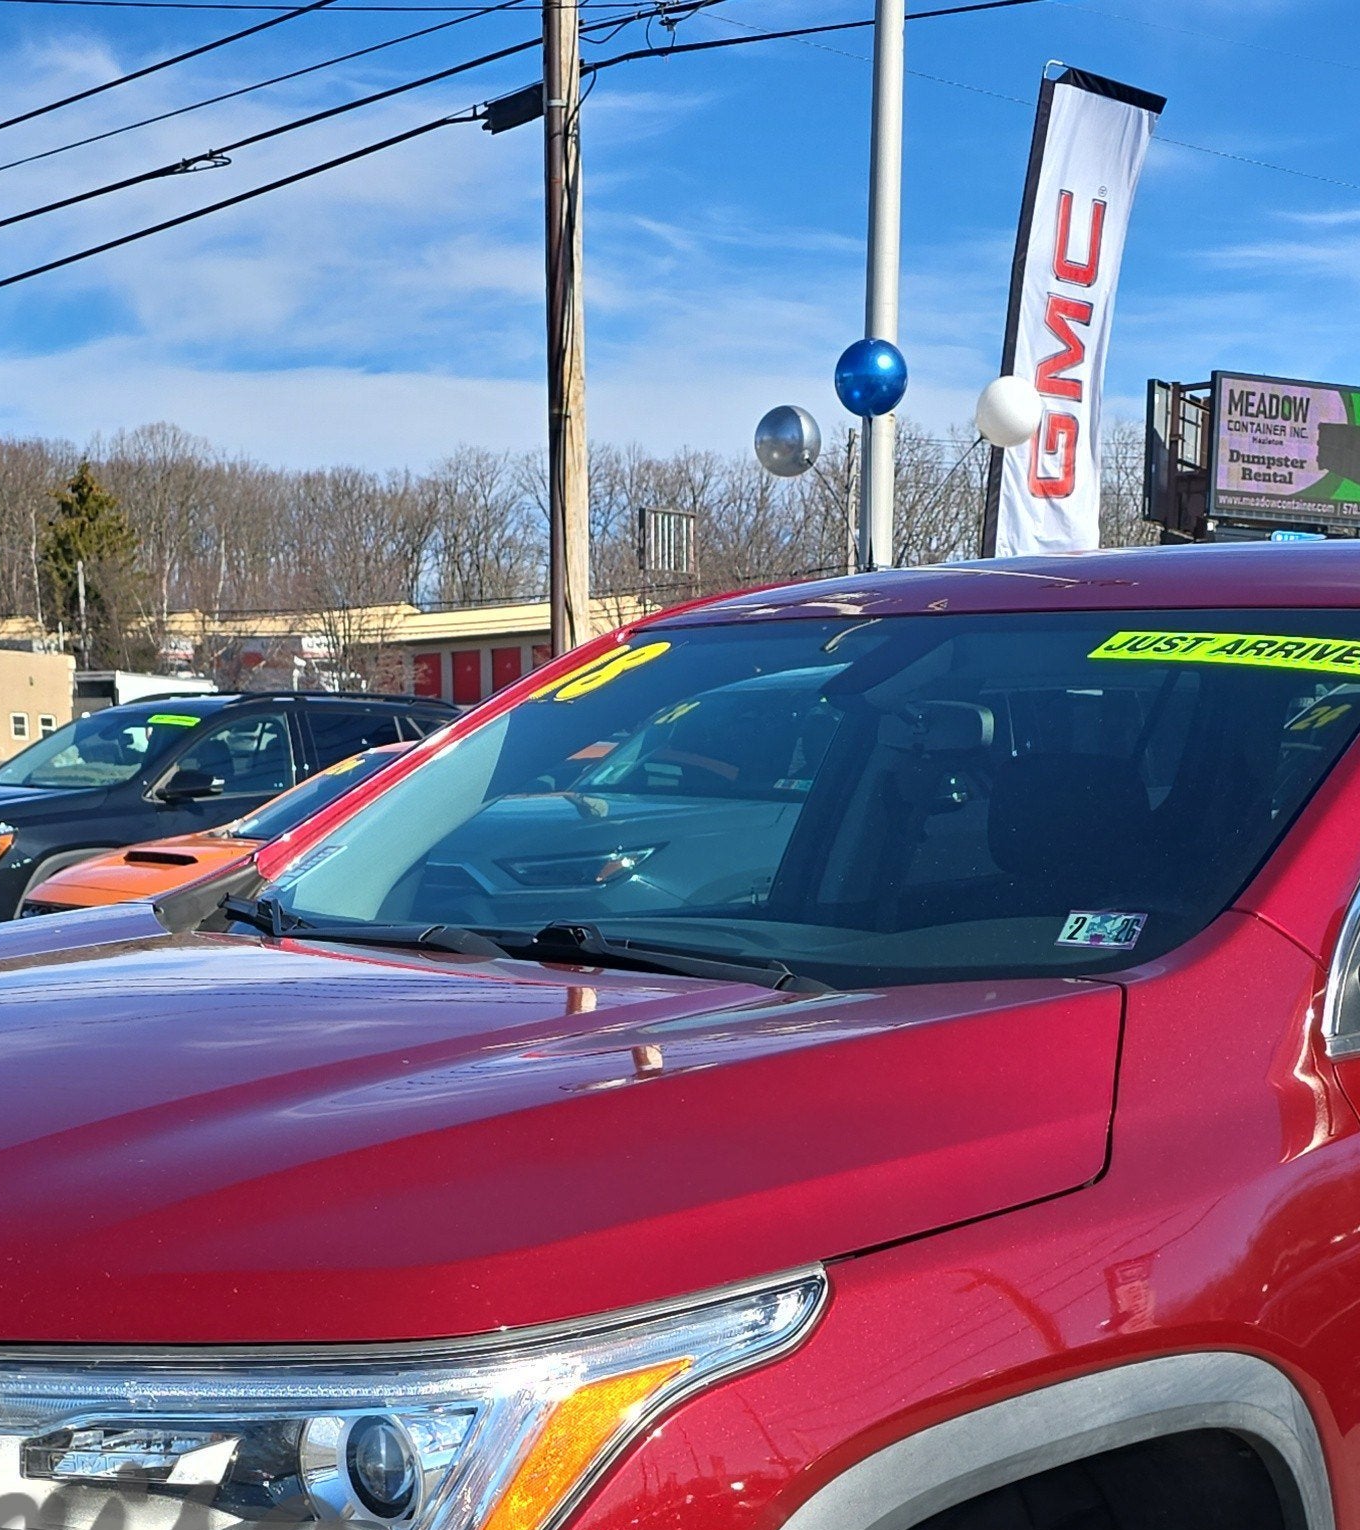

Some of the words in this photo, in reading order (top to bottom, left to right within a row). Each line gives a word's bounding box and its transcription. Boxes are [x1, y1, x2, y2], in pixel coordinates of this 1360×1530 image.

[1028, 189, 1107, 499] GMC
[1228, 389, 1310, 424] MEADOW
[1227, 420, 1287, 437] CONTAINER
[1289, 426, 1309, 439] INC.
[1228, 449, 1308, 470] Dumpster
[1241, 466, 1294, 485] Rental
[1103, 634, 1216, 654] JUST
[1066, 916, 1088, 940] 2
